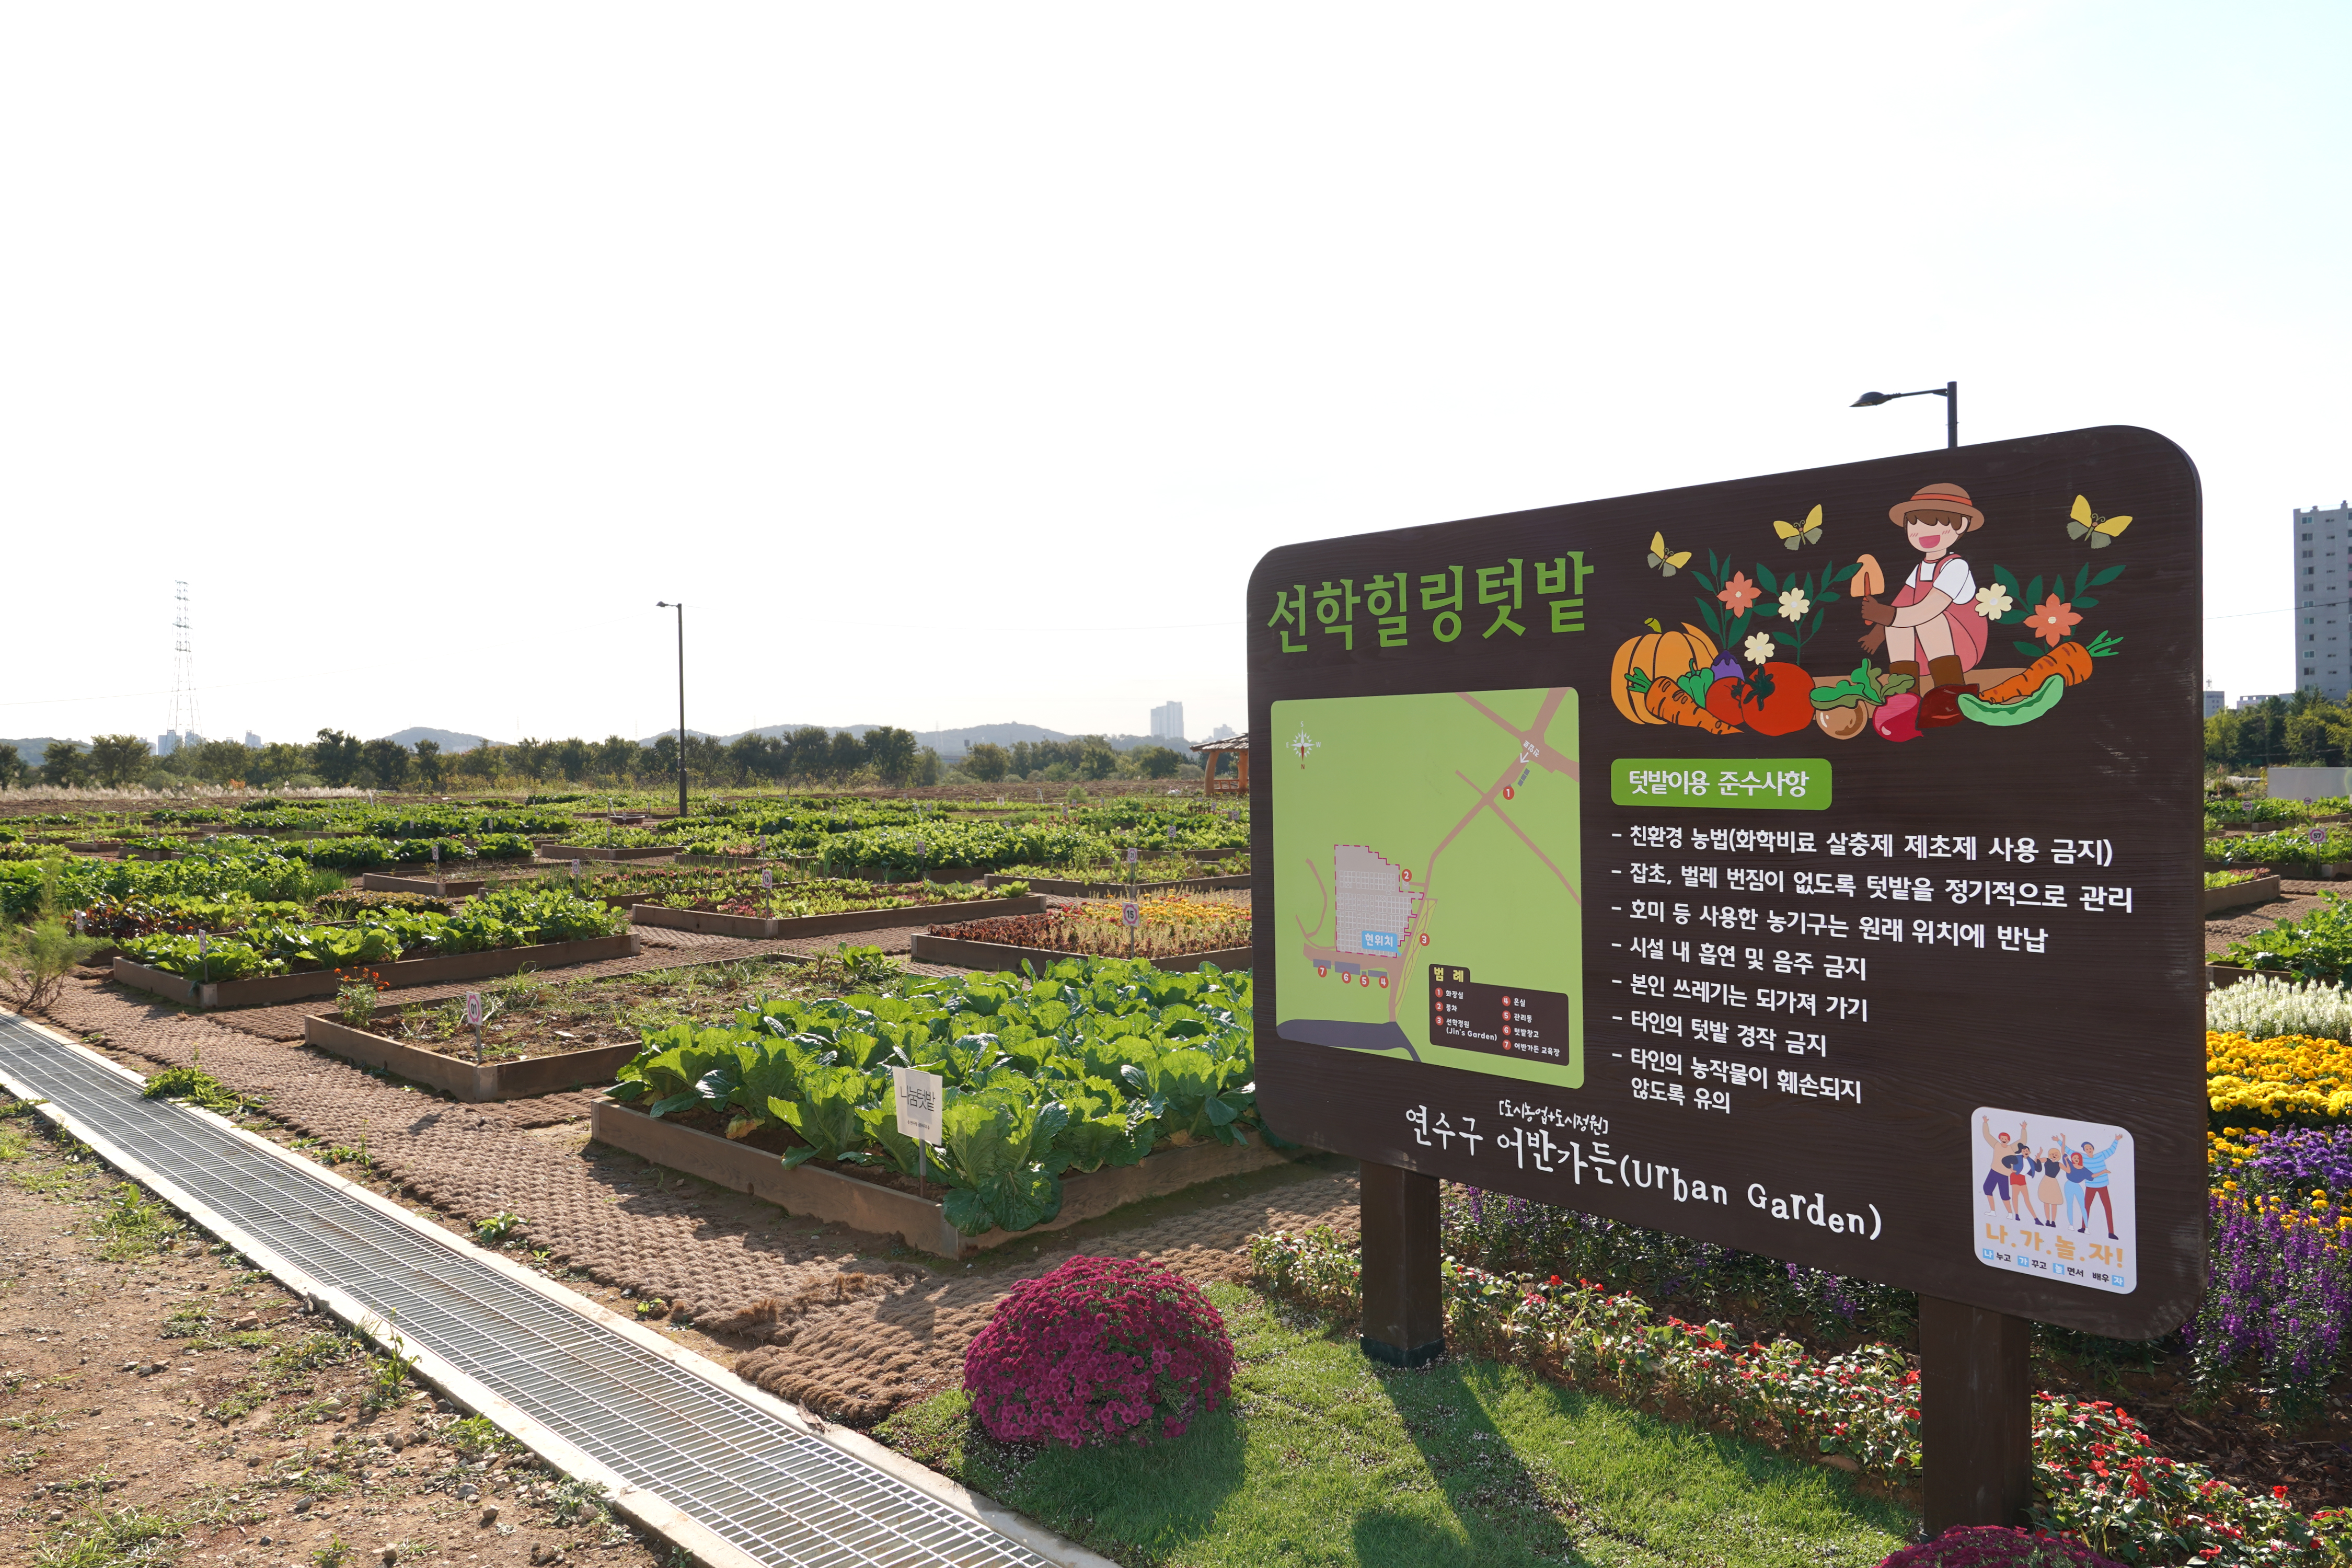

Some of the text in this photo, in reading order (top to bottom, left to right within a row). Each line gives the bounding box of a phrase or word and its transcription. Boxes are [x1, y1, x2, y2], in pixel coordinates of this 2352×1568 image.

[1267, 551, 1594, 653] 선학힐링텃밭
[1523, 740, 1540, 757] 진입로
[1630, 770, 1809, 798] 텃밭이용 준수사항
[1506, 788, 1510, 797] 1
[1630, 825, 1682, 849] 친환경
[1826, 832, 1893, 857] 살충제
[1904, 834, 1976, 861] 제초제
[1988, 837, 2039, 863] 사용
[2050, 839, 2113, 867] 금지)
[1404, 871, 1409, 879] 2
[1630, 863, 2132, 914] 잡초, 벌레 번짐이 없도록 텃밭을 정기적으로 관리
[1127, 910, 1134, 919] 15
[1630, 899, 2048, 953] 호미 등 사용한 농기구는 원래 위치에 반납
[1365, 933, 1393, 947] 현위치
[1422, 935, 1427, 944] 3
[1630, 937, 1866, 981] 시설 내 흡연 및 음주 금지
[1434, 967, 1464, 983] 범 례
[1446, 989, 1463, 999] 화장실
[1630, 973, 1867, 1022] 본인 쓰레기는 되가져 가기
[470, 1003, 477, 1016] 01
[1446, 1004, 1458, 1012] 풍차
[1514, 998, 1526, 1007] 온실
[1446, 1018, 1469, 1029] 선학정원
[1514, 1013, 1532, 1023] 관리동
[1446, 1027, 1497, 1041] (Jin's Garden)
[1514, 1028, 1539, 1038] 텃밭창고
[1631, 1010, 1826, 1057] 타인의 텃밭 경작 금지
[1514, 1043, 1539, 1054] 어반가든
[1541, 1046, 1560, 1057] 교육장
[1631, 1048, 1861, 1104] 타인의 농작물이 훼손되지
[900, 1085, 935, 1112] 나눔텃밭
[1631, 1077, 1730, 1114] 않도록 유의
[1405, 1104, 1483, 1156] 연수구
[1747, 1183, 1881, 1240] Garden)
